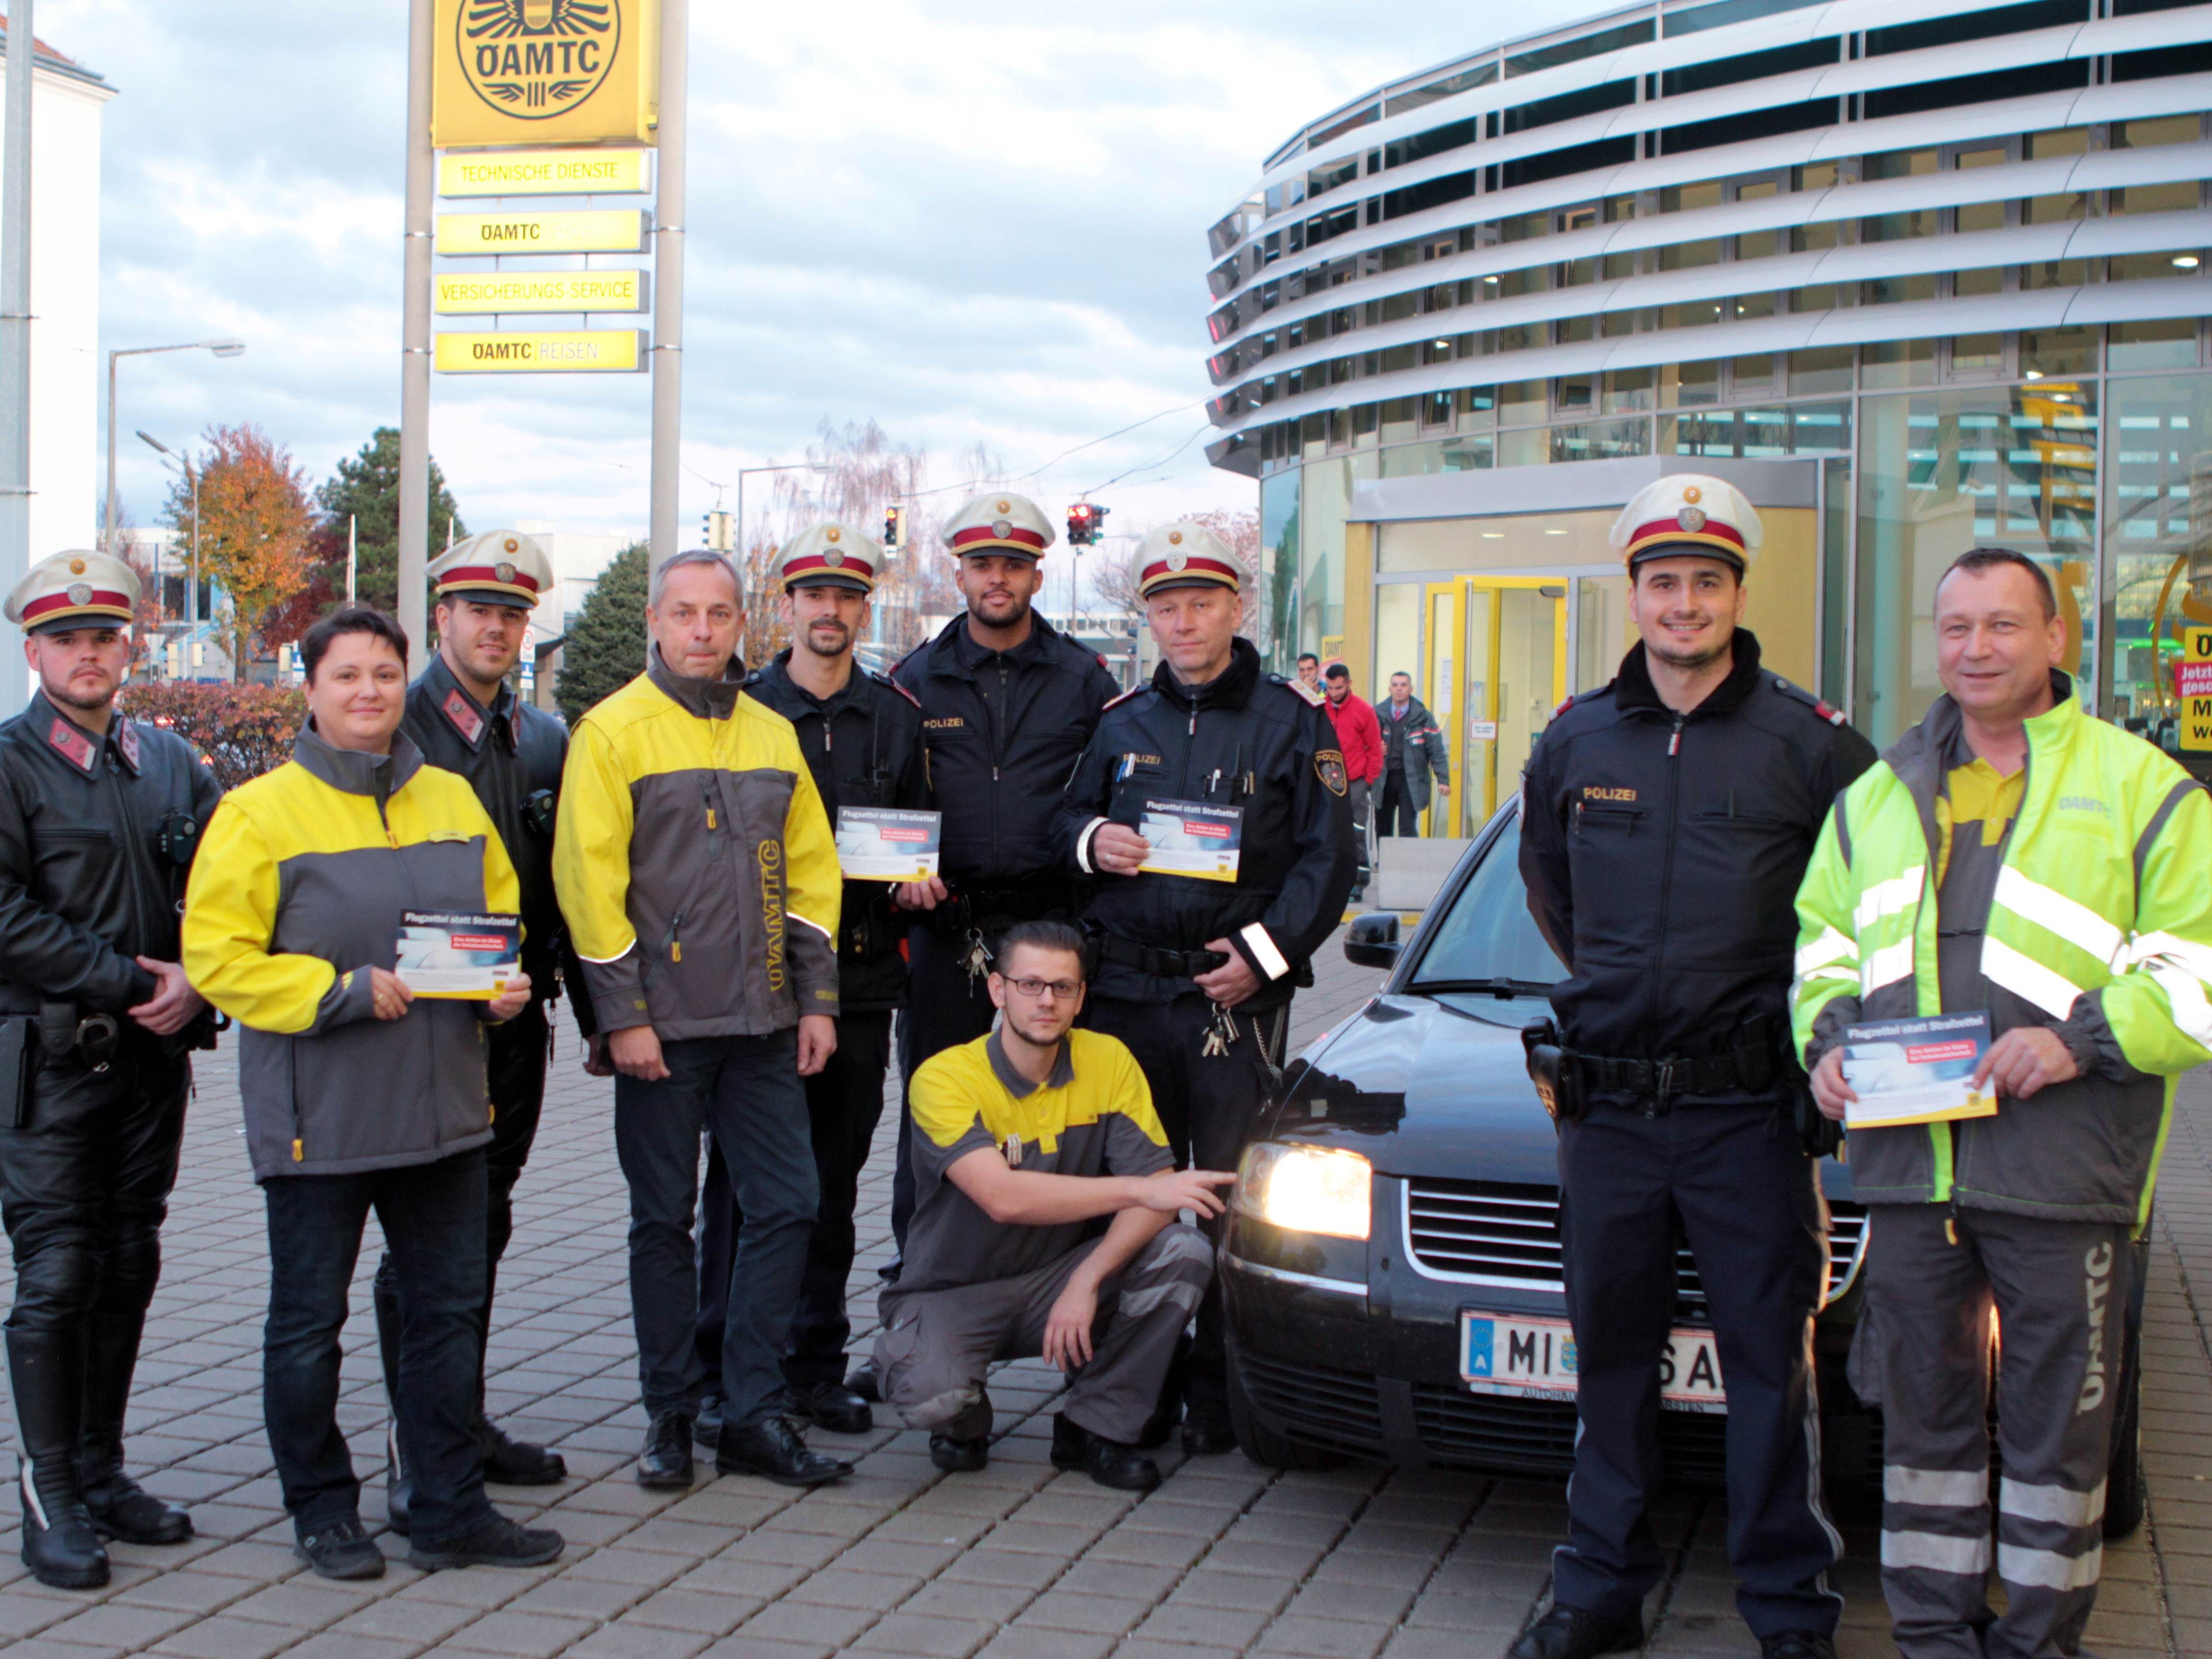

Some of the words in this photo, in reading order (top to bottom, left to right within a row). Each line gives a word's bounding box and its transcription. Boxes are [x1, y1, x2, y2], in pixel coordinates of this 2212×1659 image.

[476, 40, 600, 77] ÖAMTC
[462, 164, 553, 181] TECHNISCHE
[558, 162, 618, 179] DIENSTE
[481, 223, 540, 240] ÖAMTC
[442, 282, 631, 300] VERSICHERUNGS-SERVICE
[473, 343, 531, 359] ÖAMTC
[540, 342, 598, 359] REISEN
[1325, 641, 1344, 658] ÖAMT
[2197, 634, 2212, 656] Ö
[2182, 680, 2212, 696] gesc
[2193, 699, 2212, 716] M
[924, 718, 964, 728] POLIZEI
[1123, 754, 1161, 765] PLIZEI
[1583, 787, 1637, 801] POLIZEI
[843, 810, 878, 819] Flugzettel
[899, 814, 936, 822] Strafzettel
[1147, 801, 1182, 812] Flugzettel
[1184, 805, 1201, 814] statt
[1202, 807, 1238, 818] Strafzettel
[405, 913, 449, 924] Flugzettel
[450, 916, 471, 925] statt
[472, 916, 517, 926] Strafzettel
[1848, 1025, 1900, 1039] Flugzettel
[1902, 1023, 1928, 1034] statt
[1929, 1016, 1983, 1031] Strafzettel
[1475, 1354, 1487, 1370] A
[1509, 1329, 1551, 1375] MI
[1659, 1344, 1719, 1389] 6A
[1522, 1386, 1577, 1402] AUTOHAU
